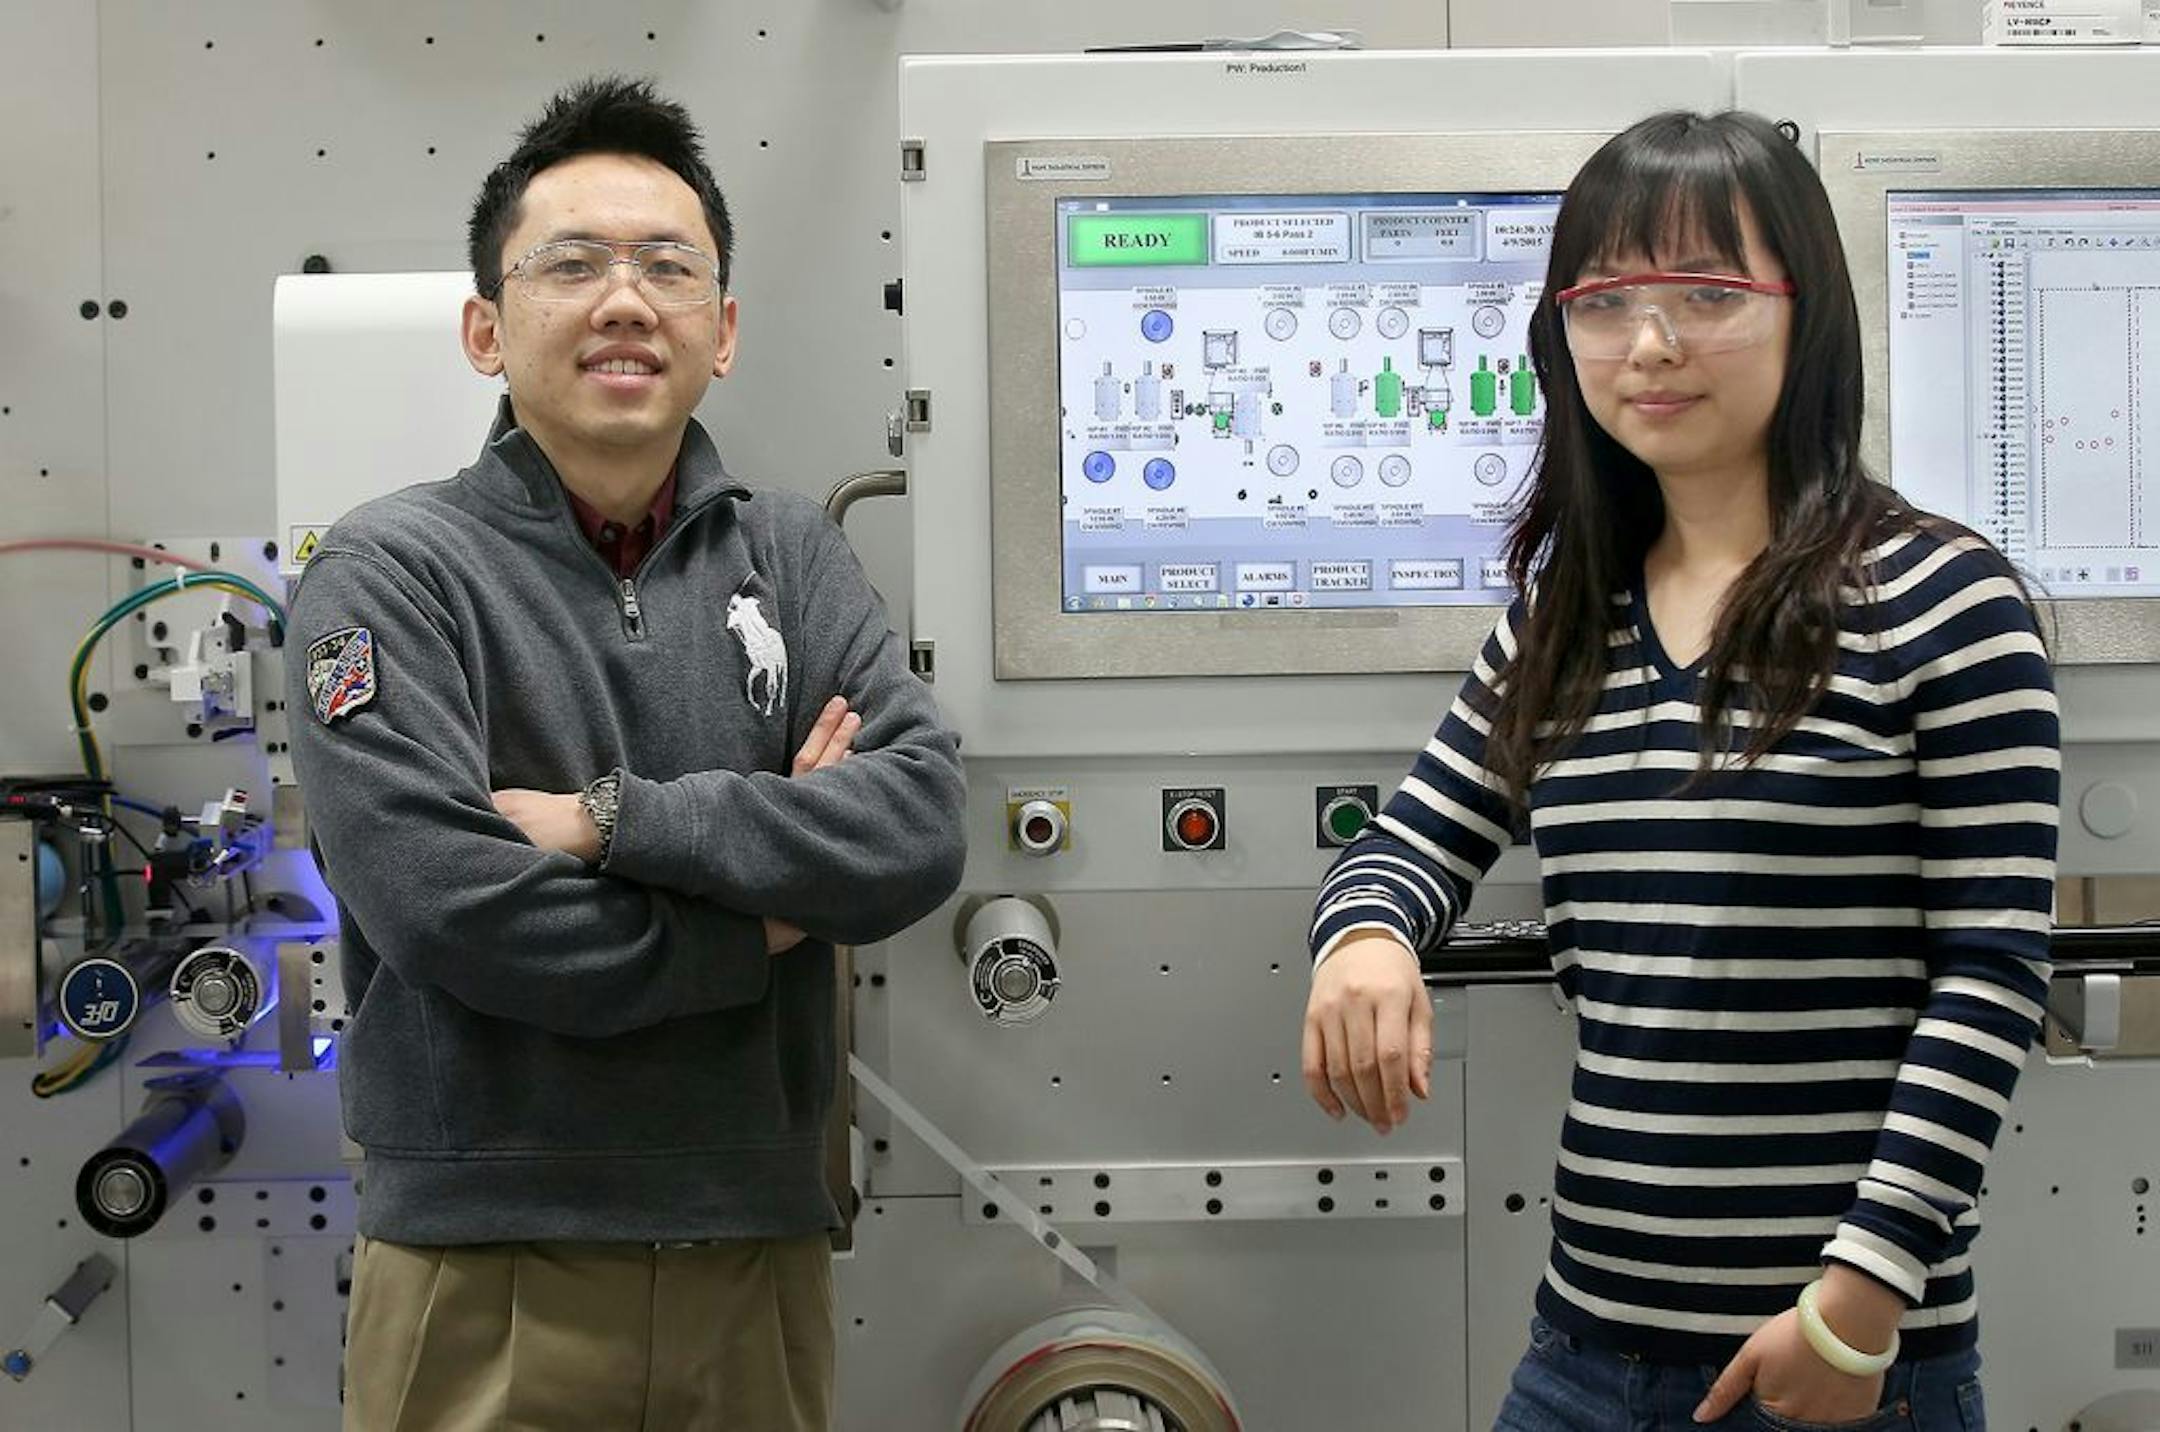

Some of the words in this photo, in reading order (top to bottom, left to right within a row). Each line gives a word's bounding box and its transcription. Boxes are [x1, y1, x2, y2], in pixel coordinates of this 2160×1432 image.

[1233, 218, 1280, 227] PRODUCT
[1282, 218, 1334, 226] SELECTED
[1307, 229, 1314, 239] 2
[1380, 229, 1413, 237] PARTS
[1104, 233, 1172, 249] READY
[1228, 250, 1261, 258] SPEED
[1161, 567, 1216, 577] PRODUCT
[1313, 565, 1367, 574] PRODUCT
[1098, 574, 1128, 583] MAIN
[1243, 572, 1289, 581] ALARMS
[1391, 570, 1461, 579] INSPECTION
[1168, 580, 1210, 589] SELECT
[1315, 577, 1368, 587] TRACKER
[1336, 788, 1358, 797] START
